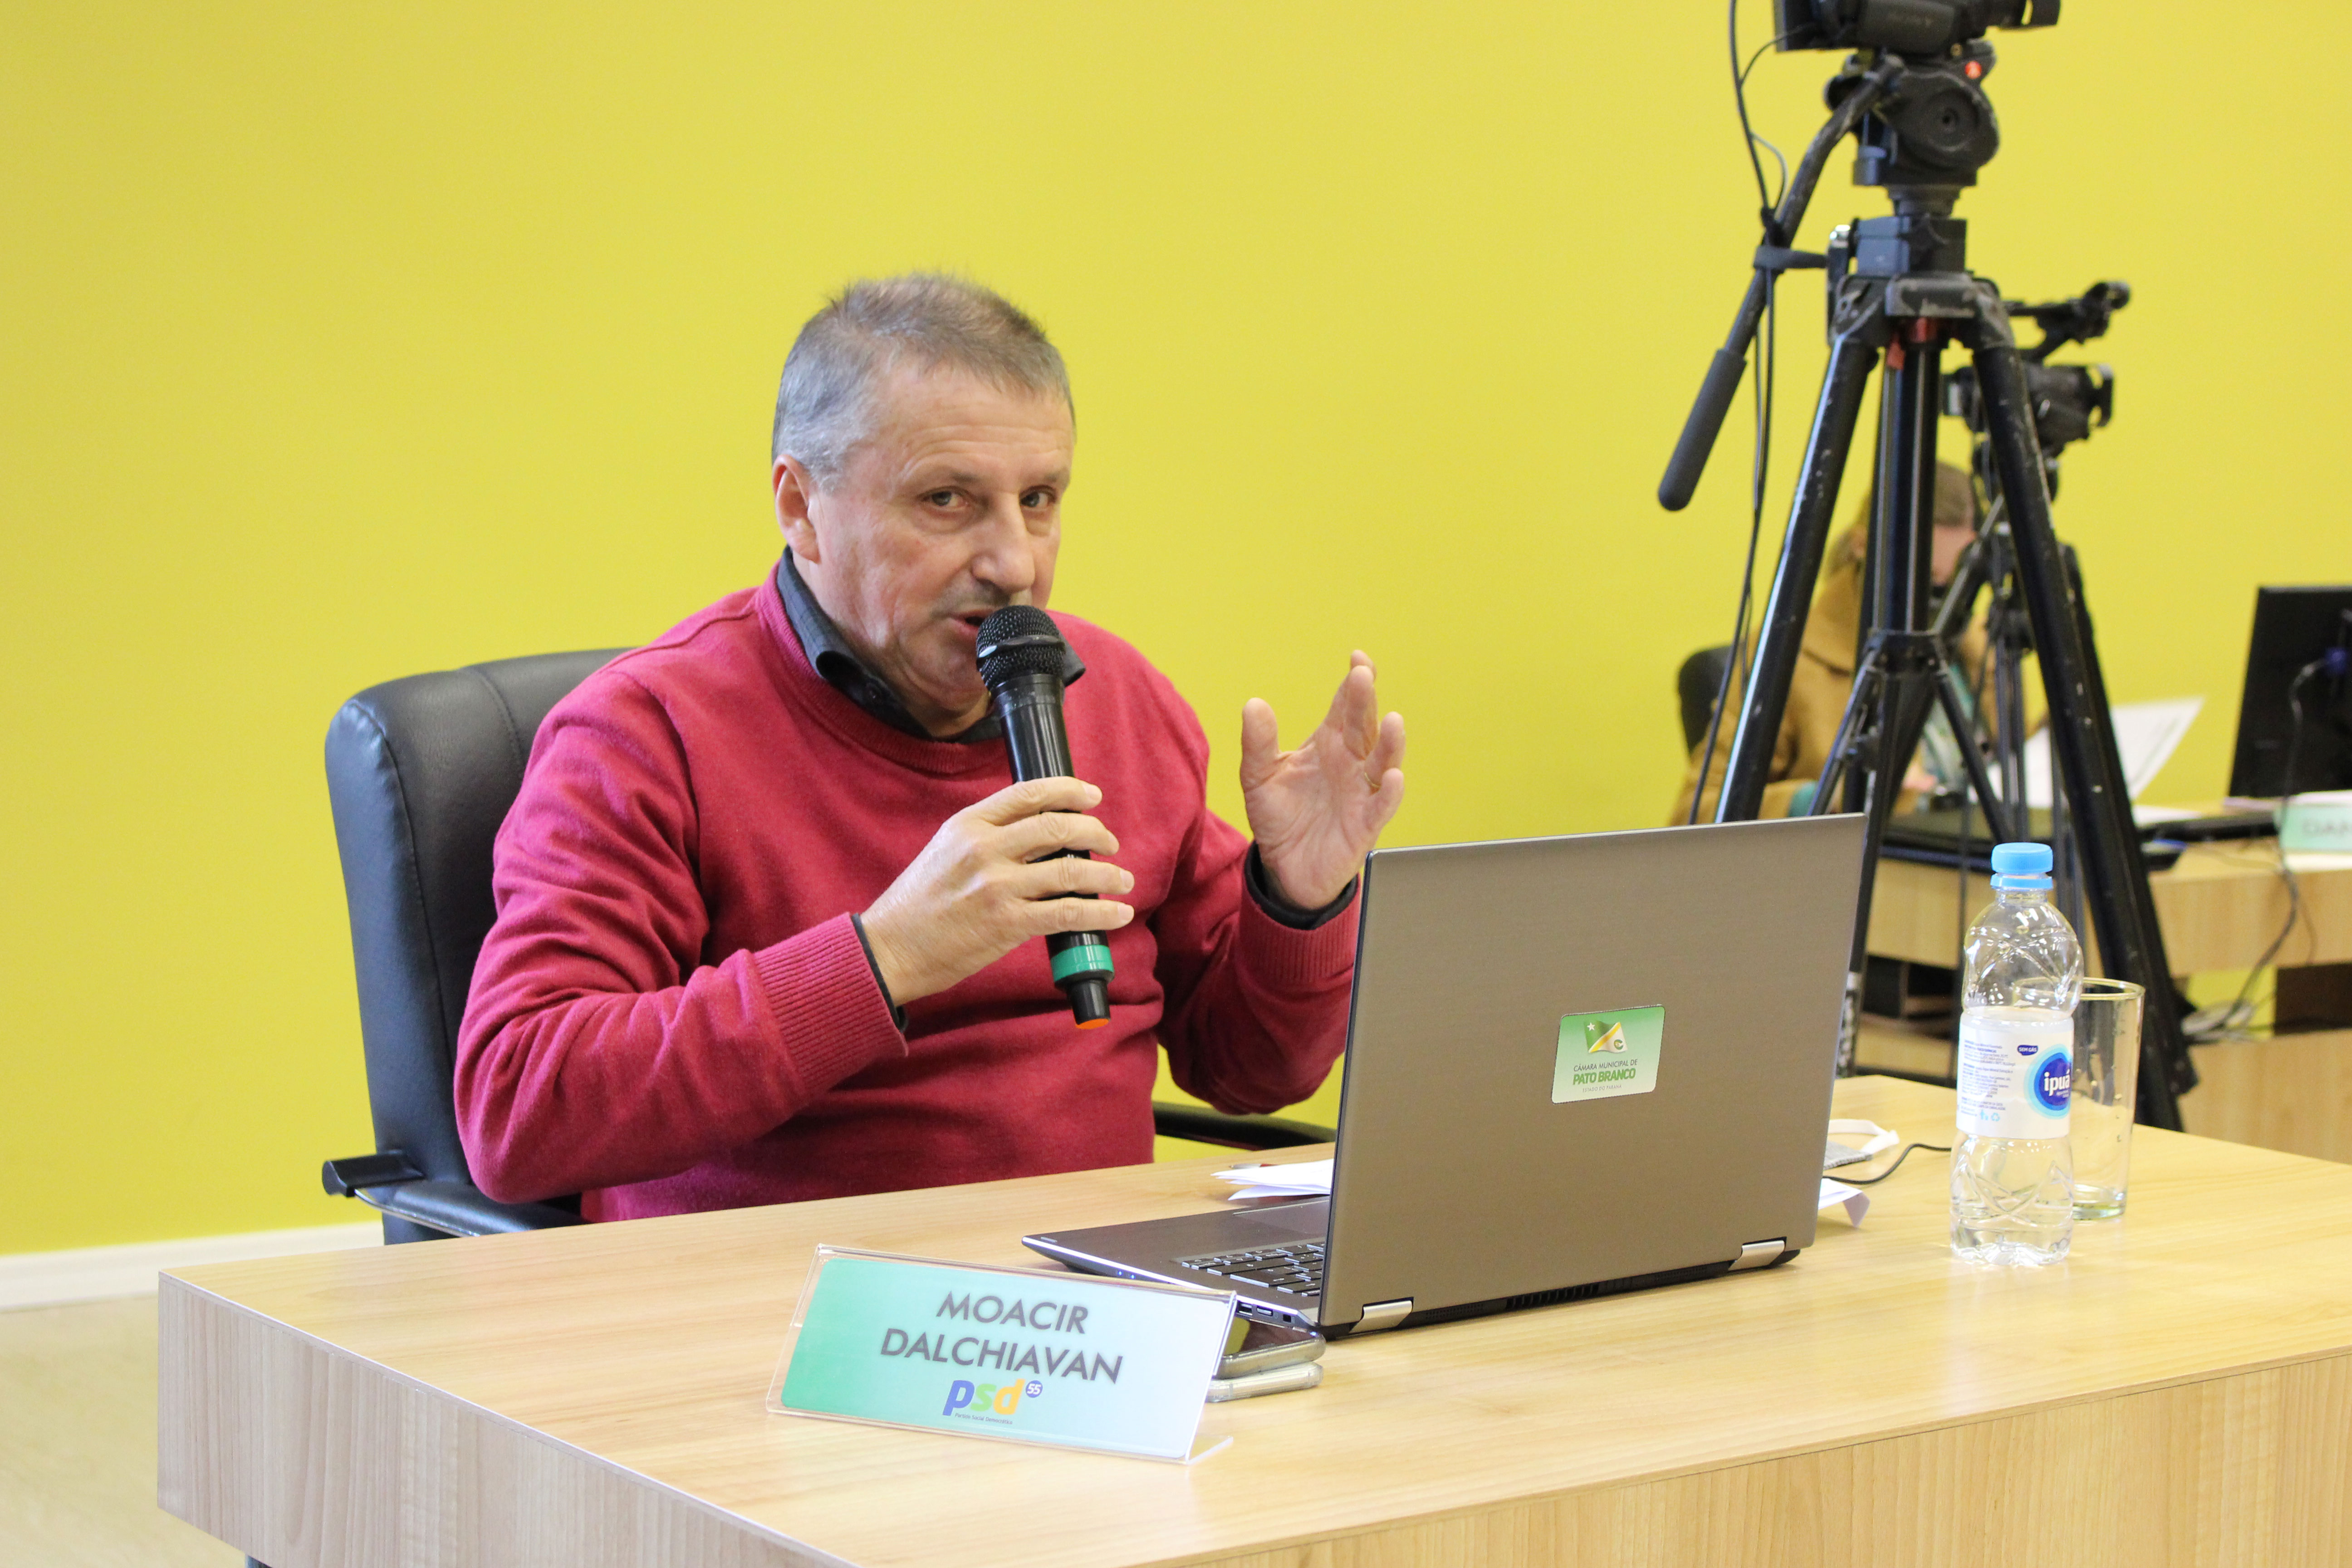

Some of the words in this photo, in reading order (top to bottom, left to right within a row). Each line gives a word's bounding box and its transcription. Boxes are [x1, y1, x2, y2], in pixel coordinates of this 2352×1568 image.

[1573, 1072, 1597, 1085] PATO
[1597, 1068, 1636, 1083] BRANCO
[1598, 1060, 1629, 1068] MUNICIPAL
[2044, 1069, 2070, 1096] ipuá
[936, 1290, 1088, 1334] MOACIR
[880, 1328, 1123, 1385] DALCHIAVAN
[942, 1378, 1026, 1416] psd
[1027, 1383, 1042, 1395] 55
